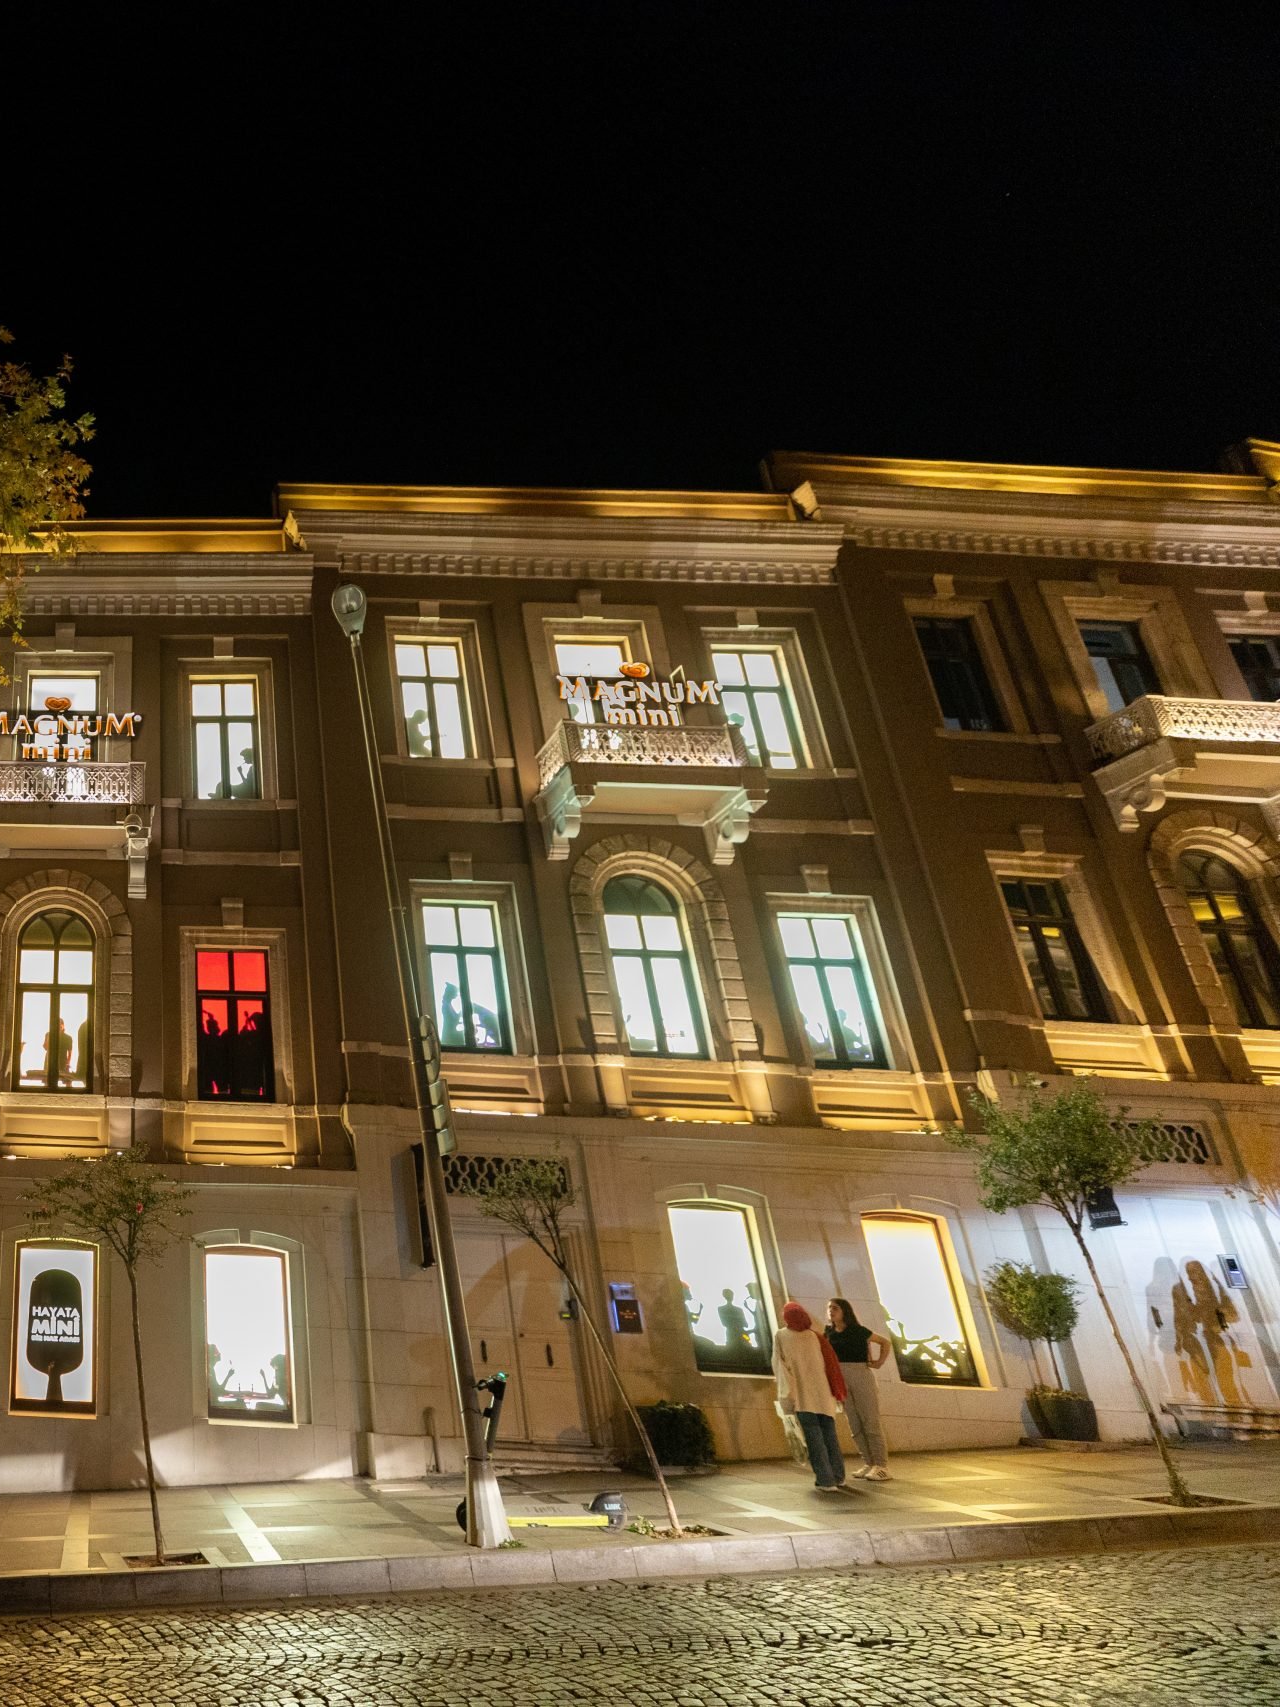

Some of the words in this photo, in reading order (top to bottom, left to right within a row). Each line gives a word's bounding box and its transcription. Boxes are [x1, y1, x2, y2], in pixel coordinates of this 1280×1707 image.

[556, 675, 720, 705] MAGNUM
[608, 703, 681, 727] mini
[22, 738, 92, 761] mini
[32, 1306, 80, 1318] HAYATA
